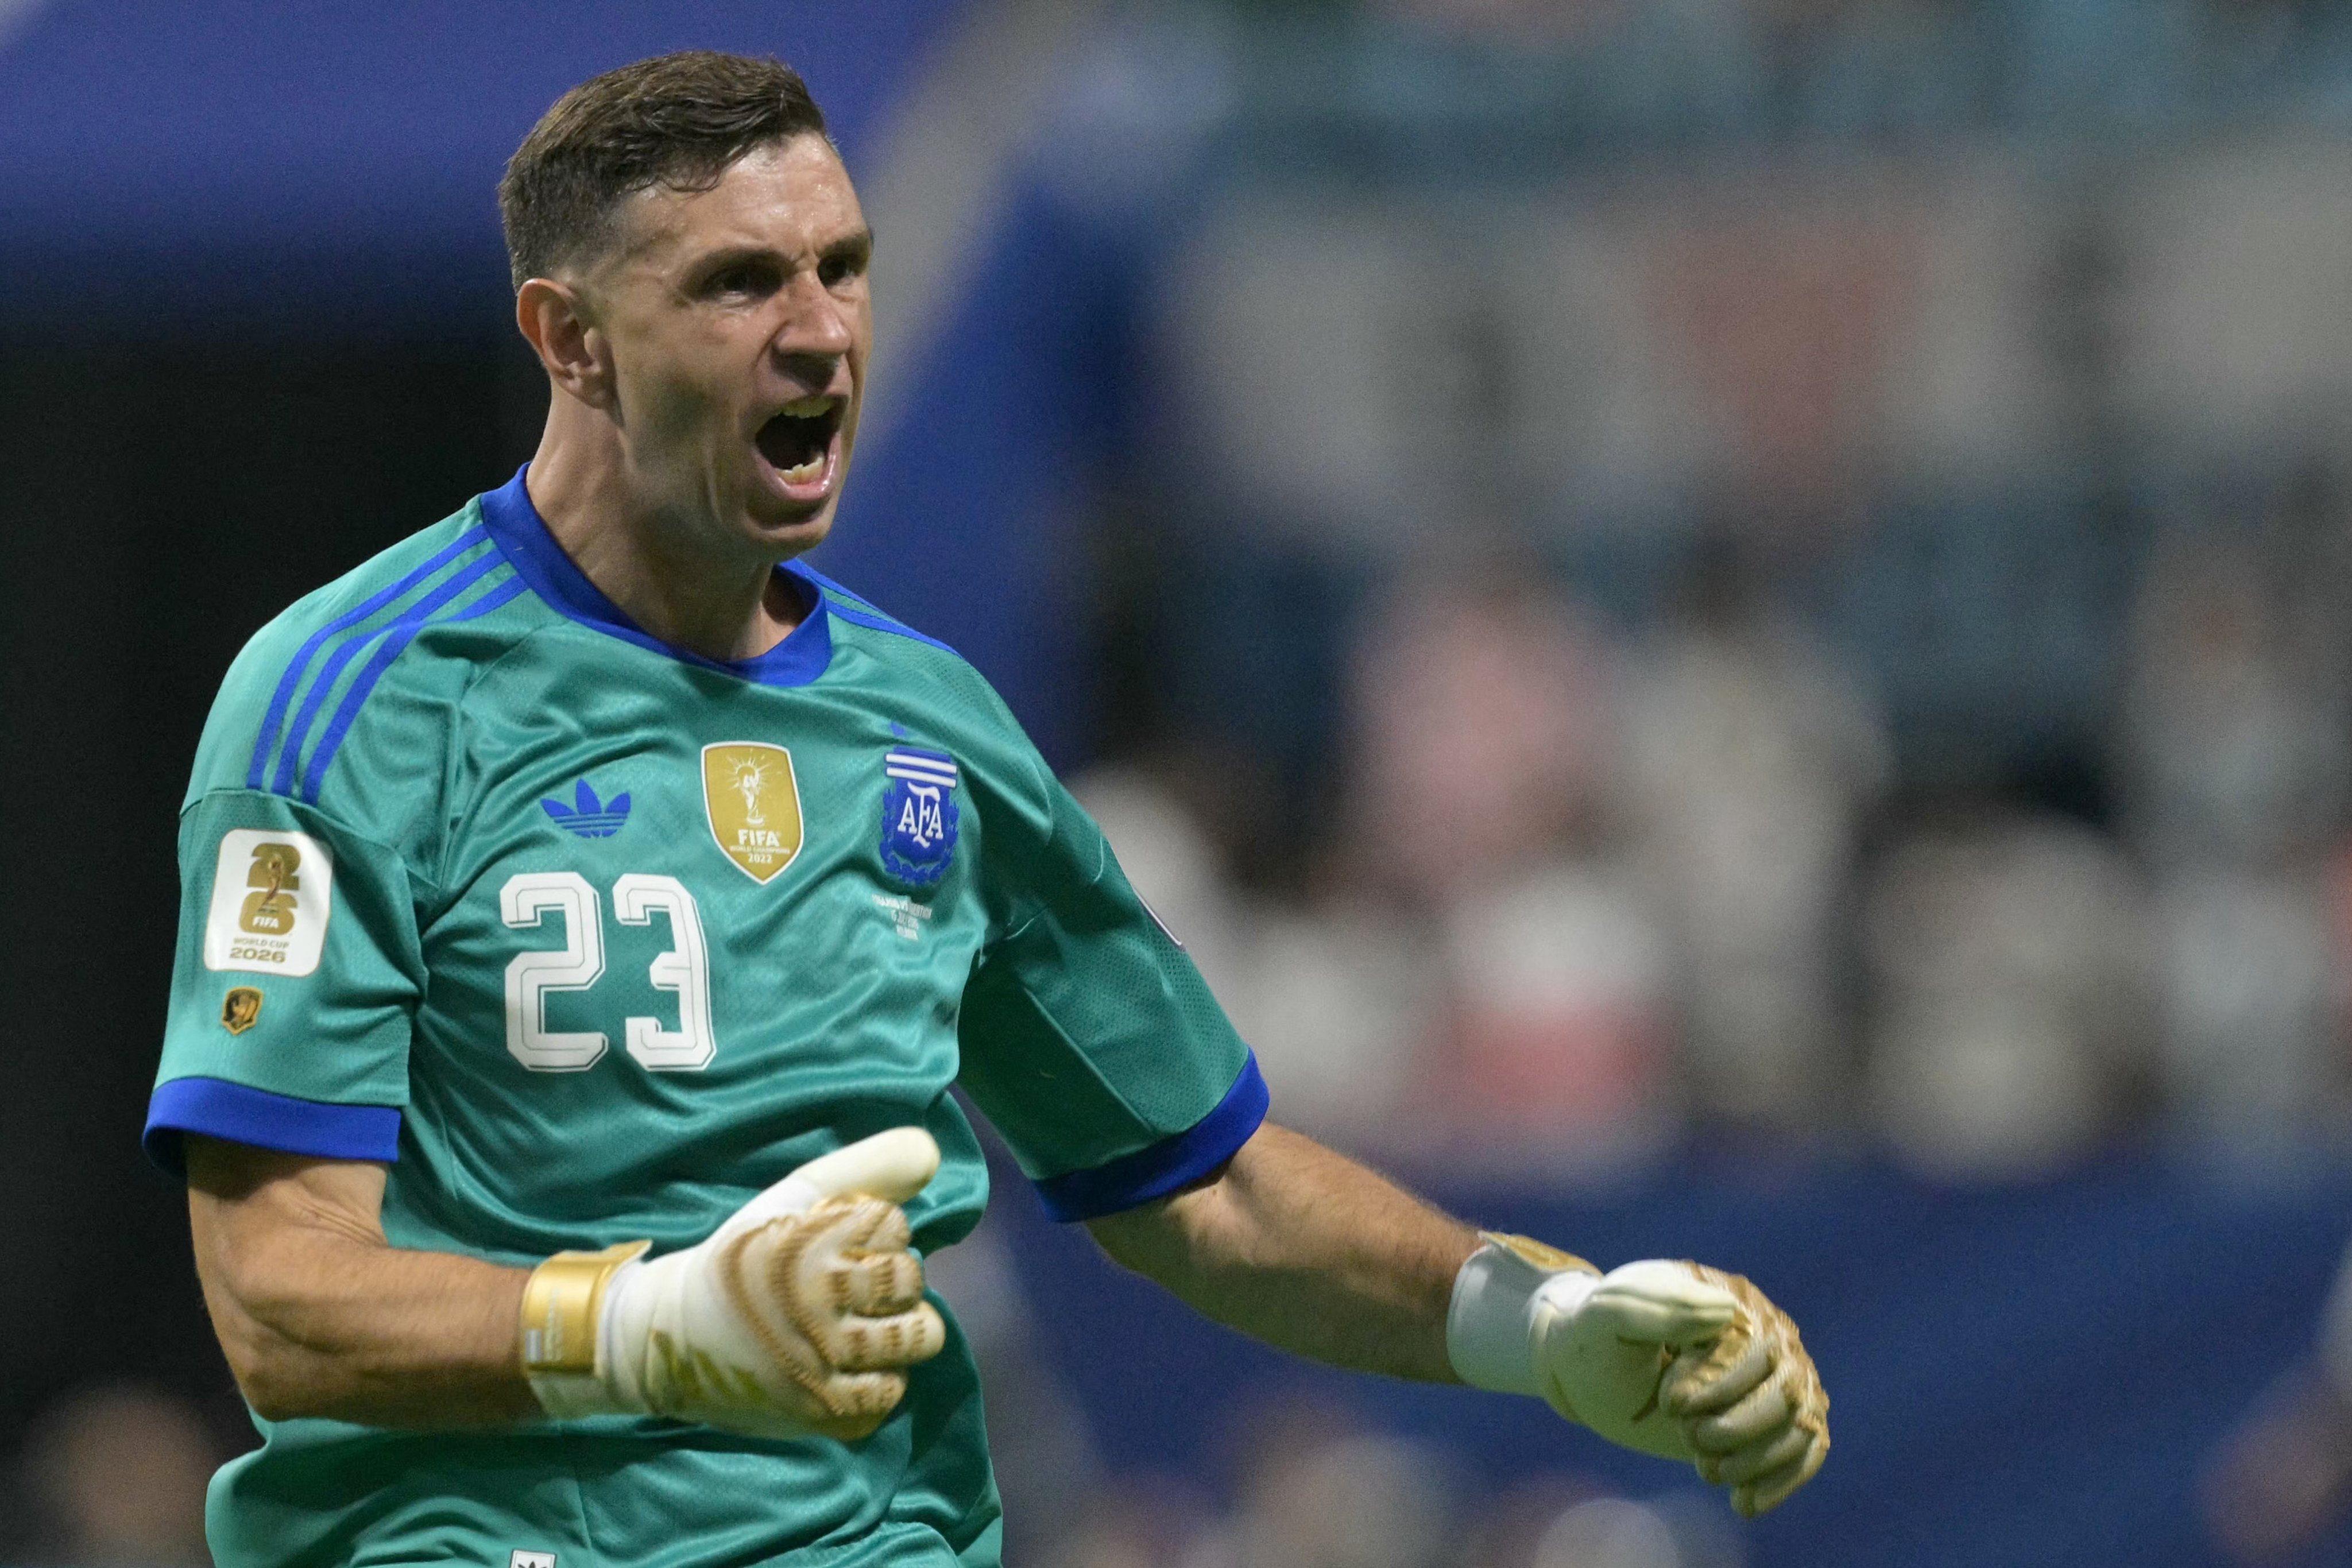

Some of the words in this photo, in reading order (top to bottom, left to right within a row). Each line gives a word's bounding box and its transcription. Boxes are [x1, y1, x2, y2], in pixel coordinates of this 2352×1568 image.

[738, 829, 780, 846] FIFA
[748, 853, 772, 864] 2022
[253, 916, 279, 928] FIFA
[233, 937, 268, 946] WORLD
[269, 940, 289, 948] CUP
[230, 948, 286, 963] 2026
[500, 872, 717, 1072] 23
